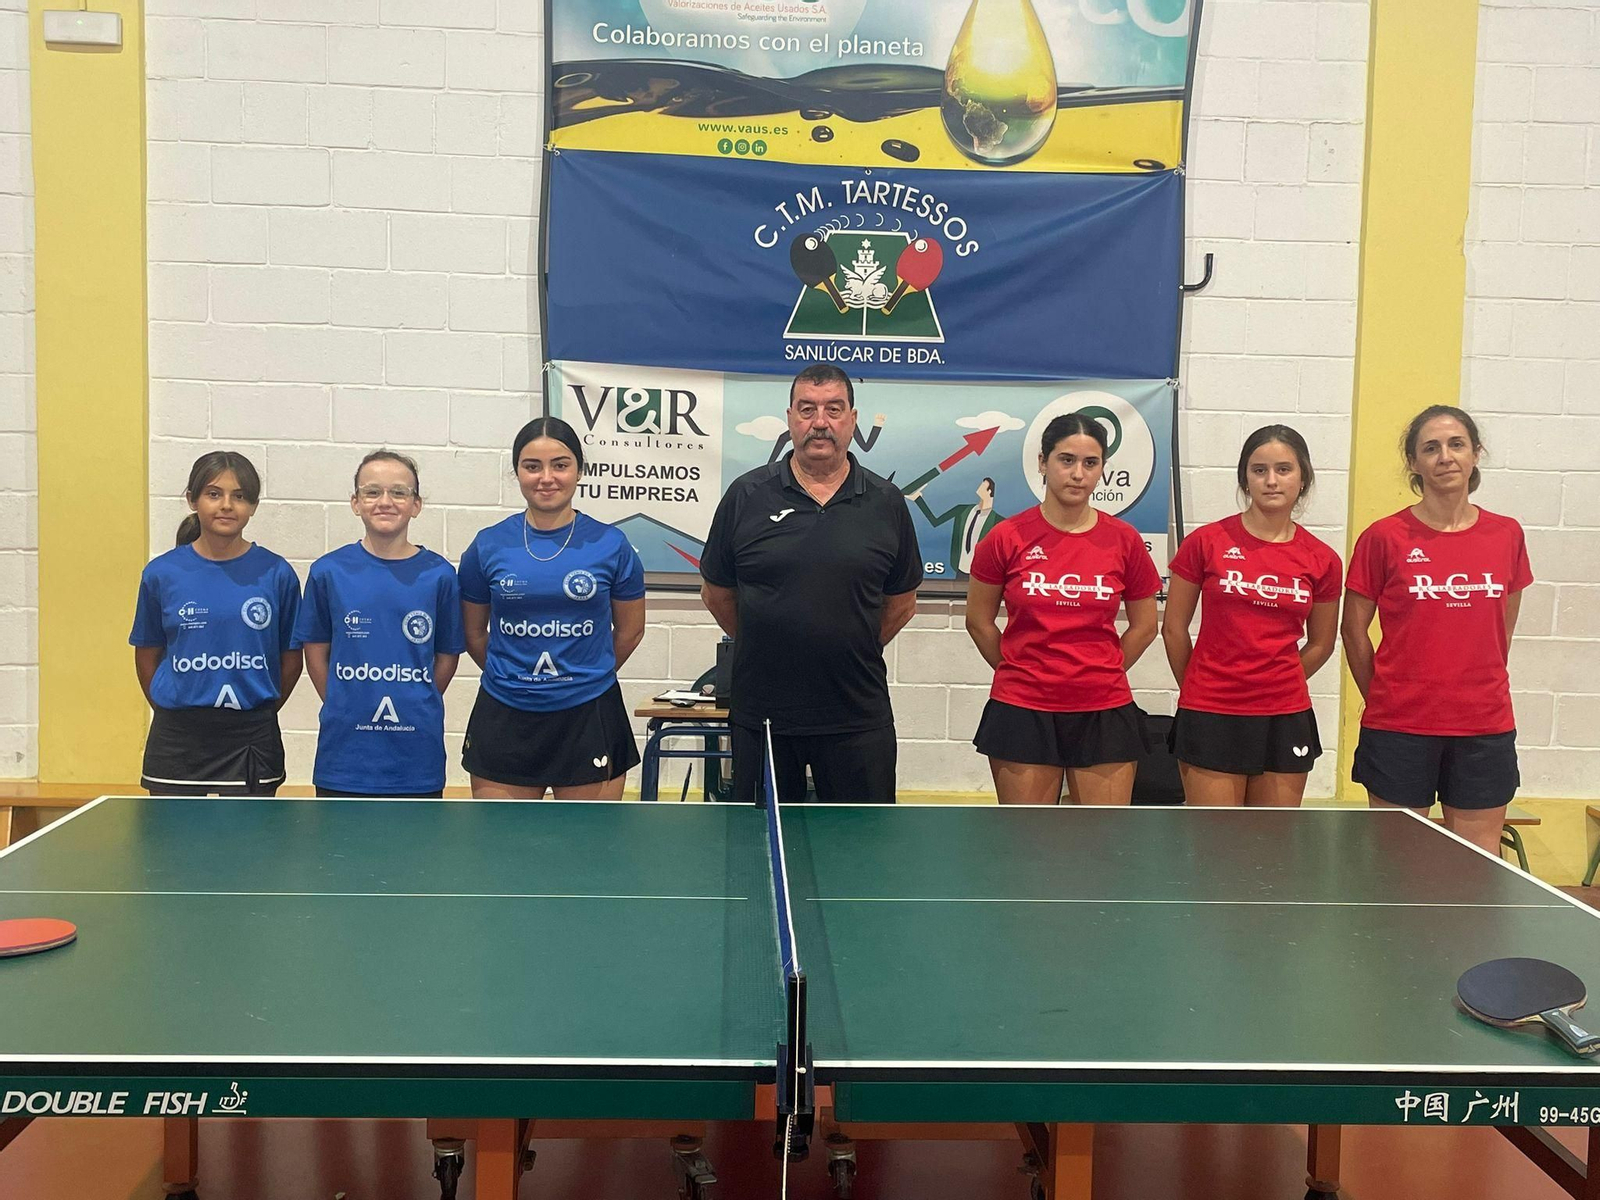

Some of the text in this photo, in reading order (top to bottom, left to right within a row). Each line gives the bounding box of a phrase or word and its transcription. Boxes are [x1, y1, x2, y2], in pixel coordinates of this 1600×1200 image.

[668, 0, 729, 10] Valorizaciones
[731, 1, 741, 11] de
[744, 2, 775, 13] Aceites
[777, 3, 809, 13] Usados
[737, 13, 827, 23] Safeguarding the Environment
[592, 22, 924, 58] Colaboramos con el planeta
[698, 123, 789, 135] www.vaus.es
[754, 180, 979, 257] C.T.M. TARTESSOS
[785, 341, 945, 364] SANLÚCAR DE BDA.
[567, 384, 710, 436] V&R
[583, 433, 704, 450] Consultores
[583, 462, 700, 480] MPULSAMOS
[577, 483, 699, 502] TU EMPRESA
[1091, 489, 1124, 502] nción
[1252, 600, 1278, 608] SEVILLA
[1, 1090, 129, 1115] DOUBLE
[143, 1091, 208, 1115] FISH
[1394, 1090, 1520, 1123] 中国 广州
[1539, 1106, 1600, 1124] 99-45G
